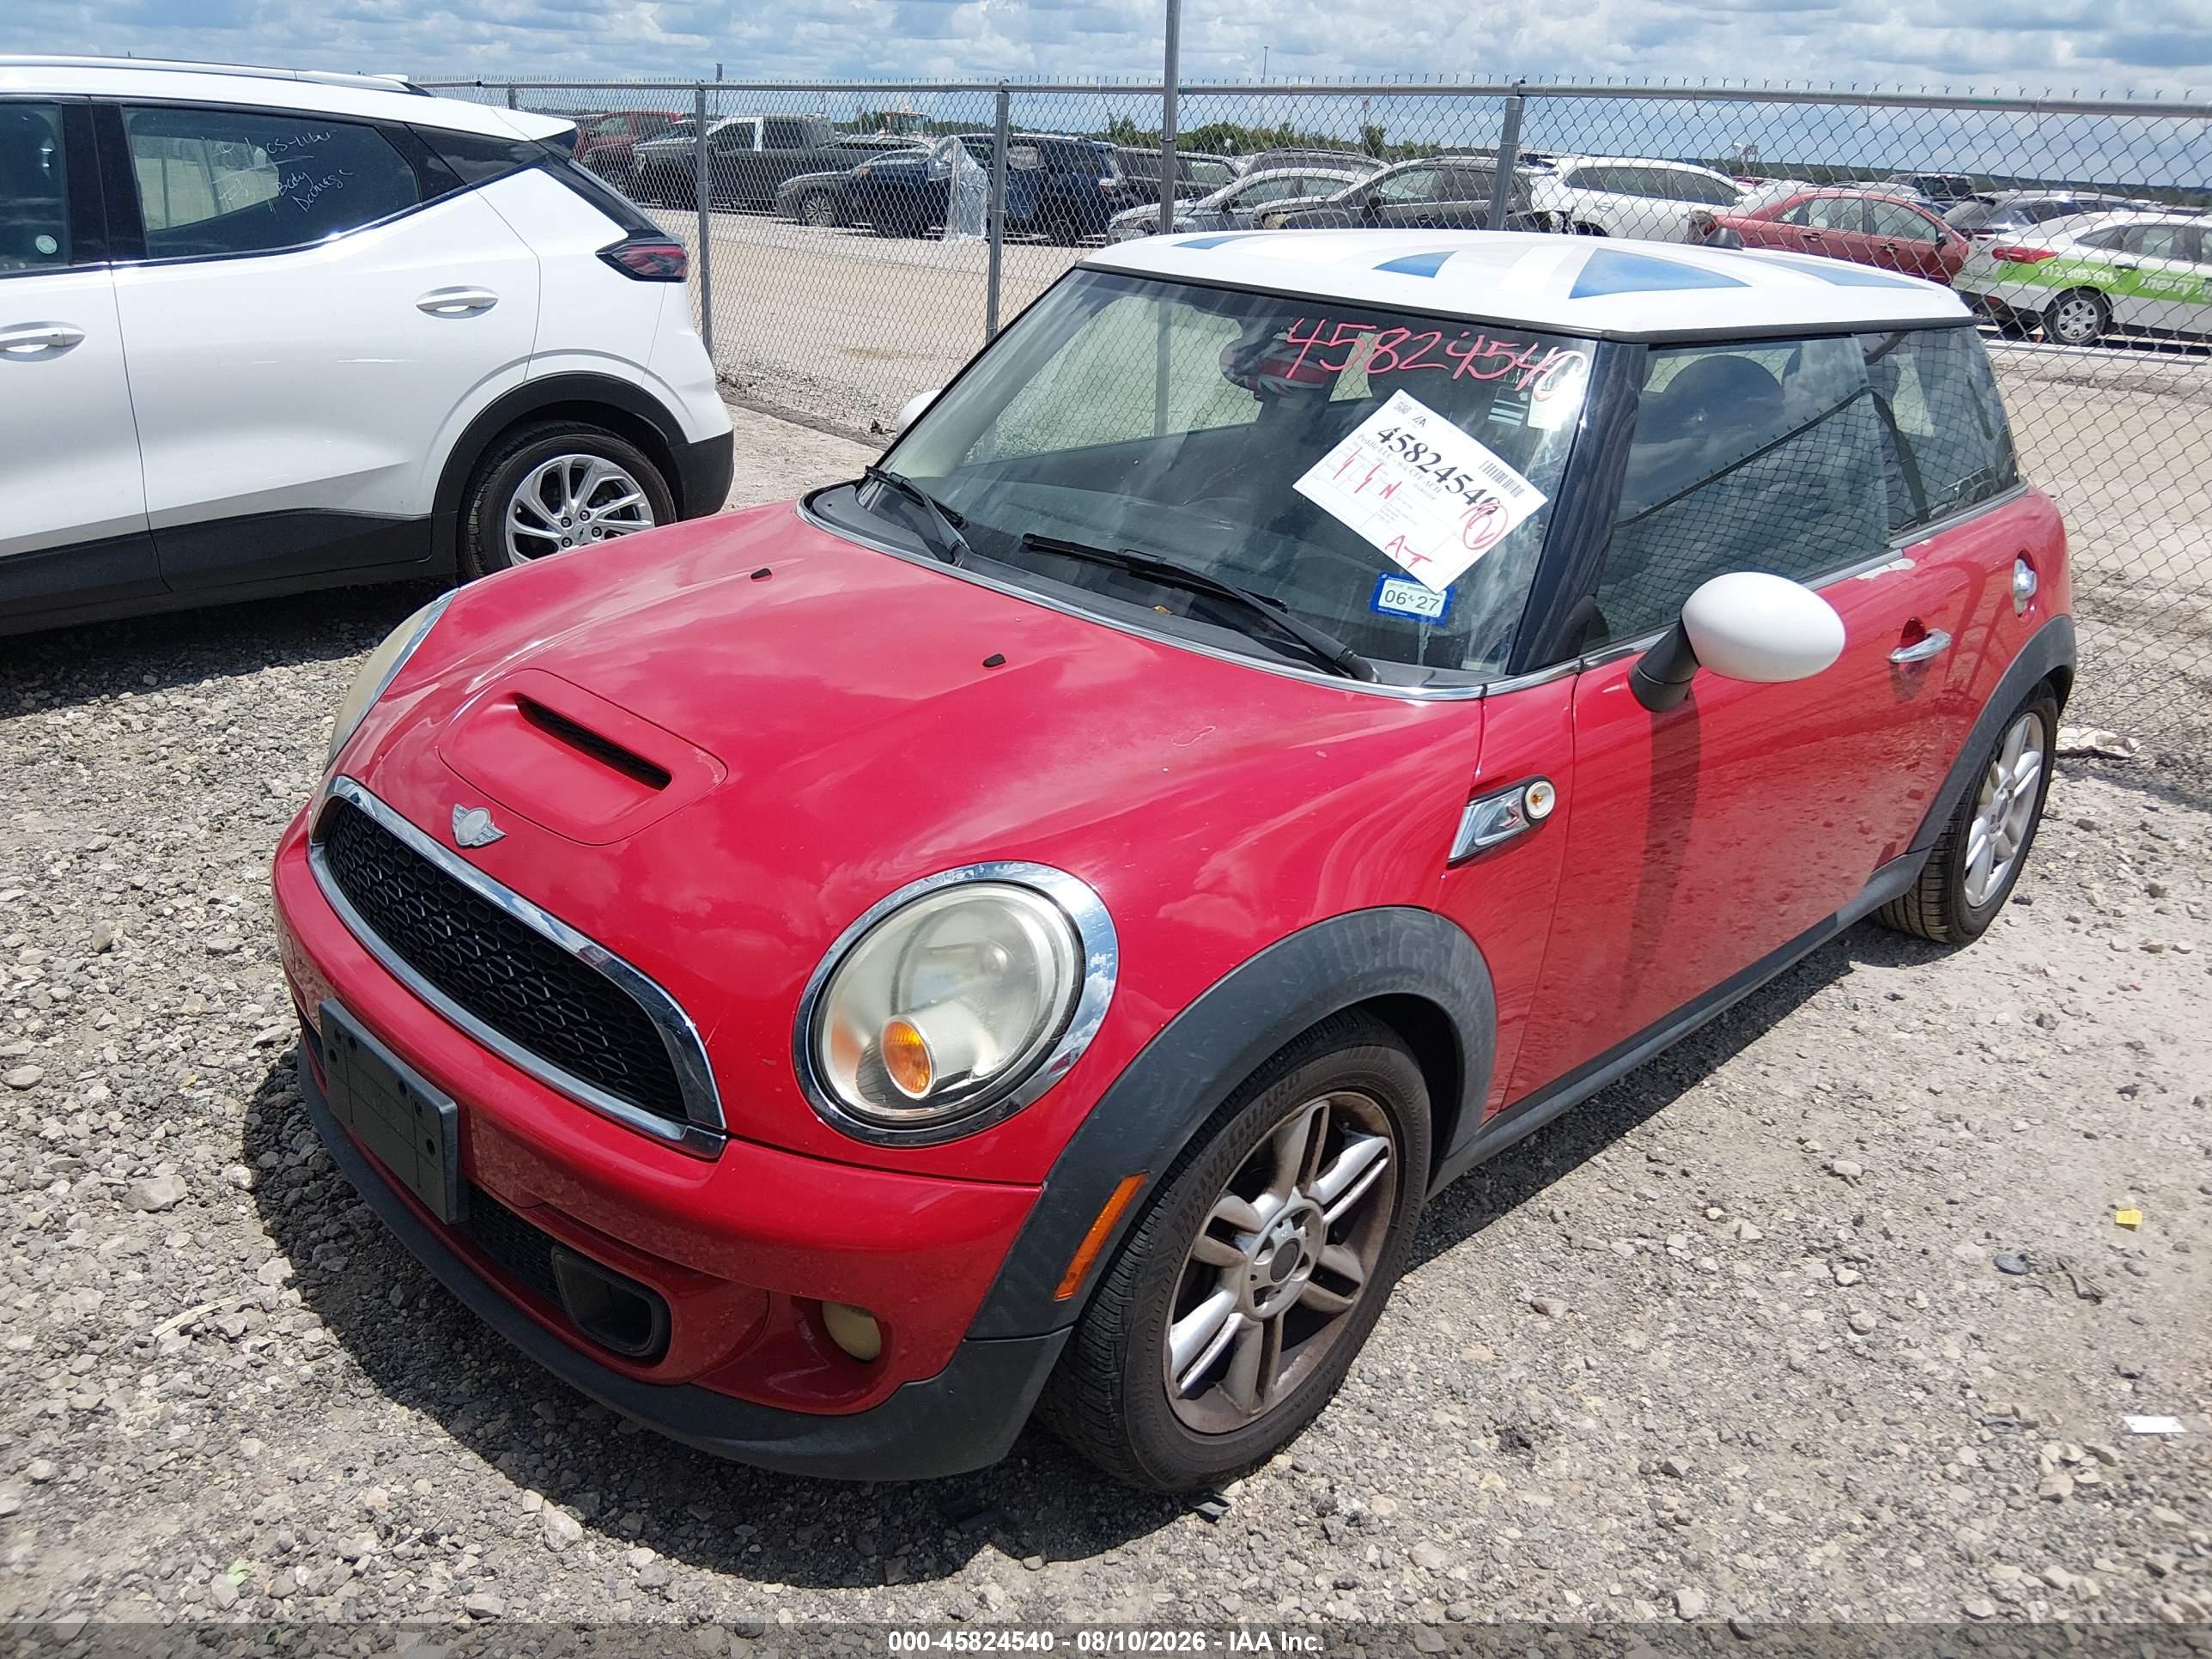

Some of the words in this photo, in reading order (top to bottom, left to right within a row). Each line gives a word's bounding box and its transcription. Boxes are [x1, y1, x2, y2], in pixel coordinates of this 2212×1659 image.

[1286, 317, 1586, 401] 45824540
[1377, 428, 1500, 515] 45824540
[1384, 588, 1407, 606] 06
[1416, 595, 1441, 612] 27
